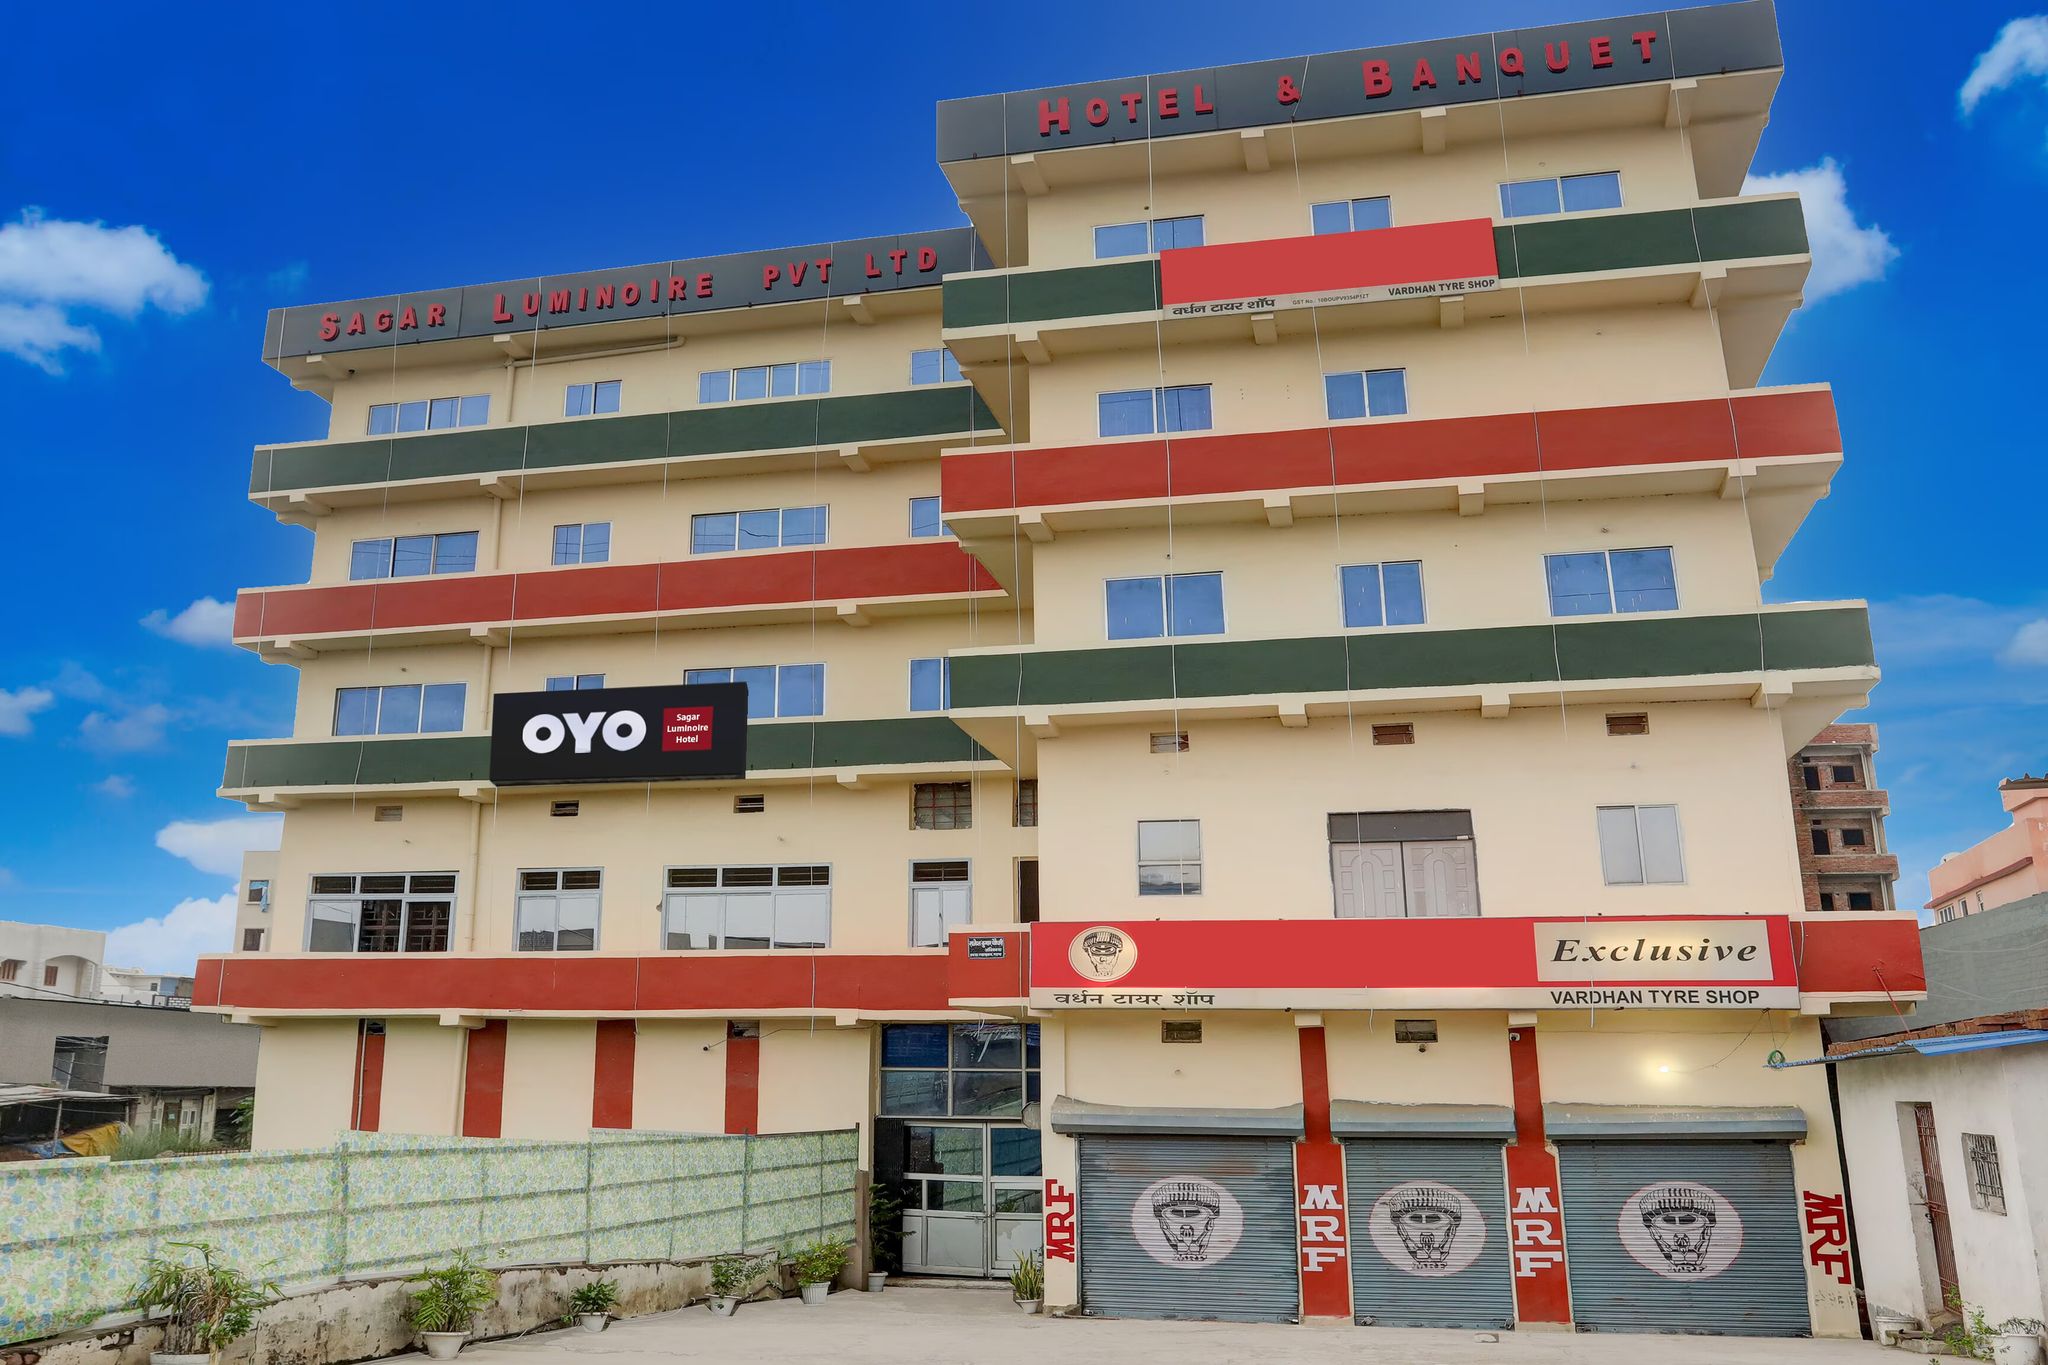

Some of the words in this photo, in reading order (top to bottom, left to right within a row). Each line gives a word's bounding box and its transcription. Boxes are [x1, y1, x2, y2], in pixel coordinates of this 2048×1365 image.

[1038, 84, 1213, 136] HOTEL
[1276, 75, 1301, 106] &
[1362, 31, 1657, 99] BANQUET
[319, 303, 446, 341] SAGAR
[492, 272, 713, 323] LUMINOIRE
[763, 258, 834, 290] PVT
[864, 247, 938, 277] LTD
[1388, 284, 1436, 296] VARDHAN
[1438, 281, 1465, 291] TYRE
[1468, 279, 1495, 289] SHOP
[1172, 304, 1207, 315] वर्धन
[1210, 302, 1244, 312] टायर
[1247, 298, 1276, 309] शॉप
[666, 723, 709, 733] Luminoire
[676, 713, 701, 723] Sagar
[522, 709, 647, 754] OYO
[675, 734, 699, 744] Hotel
[1551, 938, 1758, 963] Exclusive
[1053, 989, 1104, 1005] वर्धन
[1111, 993, 1163, 1006] टायर
[1172, 990, 1216, 1006] शॉप
[1550, 990, 1643, 1005] VARDHAN
[1647, 989, 1701, 1004] TYRE
[1704, 989, 1761, 1004] SHOP
[1044, 1178, 1076, 1264] MRF
[1302, 1185, 1344, 1272] MRF
[1512, 1186, 1563, 1278] MRF
[1802, 1190, 1853, 1286] MRF
